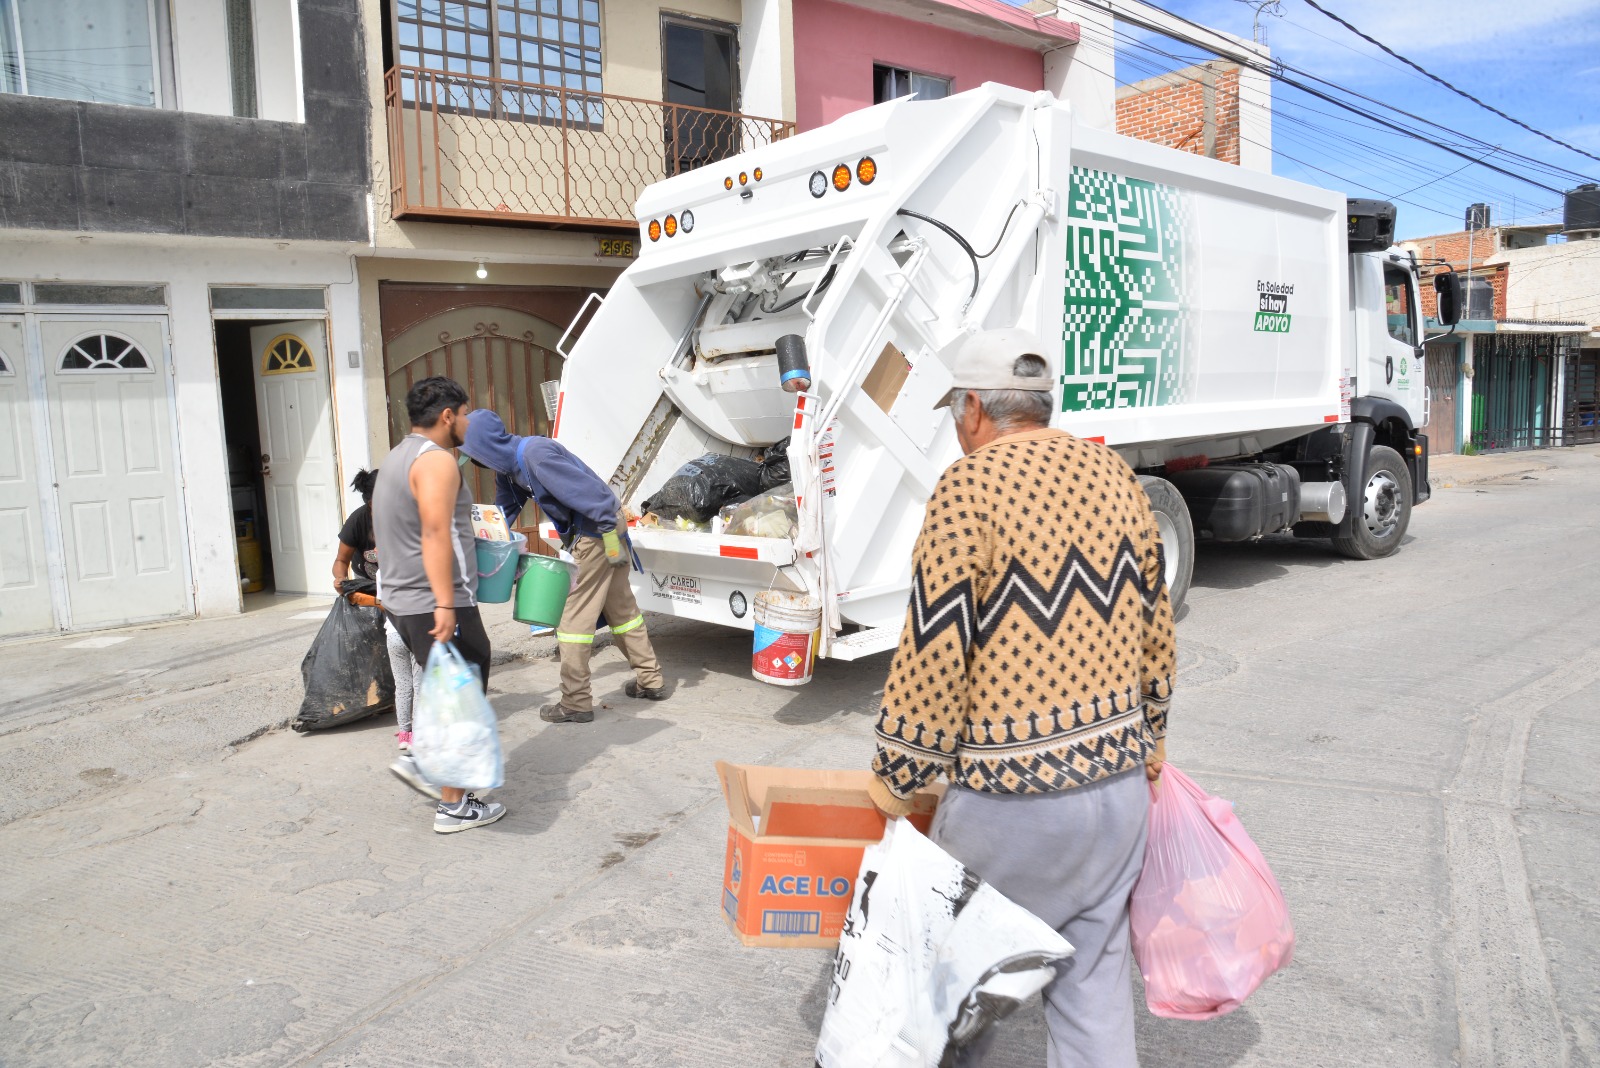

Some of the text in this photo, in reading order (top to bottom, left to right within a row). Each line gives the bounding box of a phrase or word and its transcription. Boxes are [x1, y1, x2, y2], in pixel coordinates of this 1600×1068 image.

[374, 160, 391, 224] 296
[603, 241, 631, 255] 296
[1257, 280, 1294, 295] En Soledad
[1268, 296, 1286, 313] hay
[1255, 314, 1289, 332] APOYO
[671, 576, 697, 588] CAREDI
[759, 875, 851, 897] ACE LO
